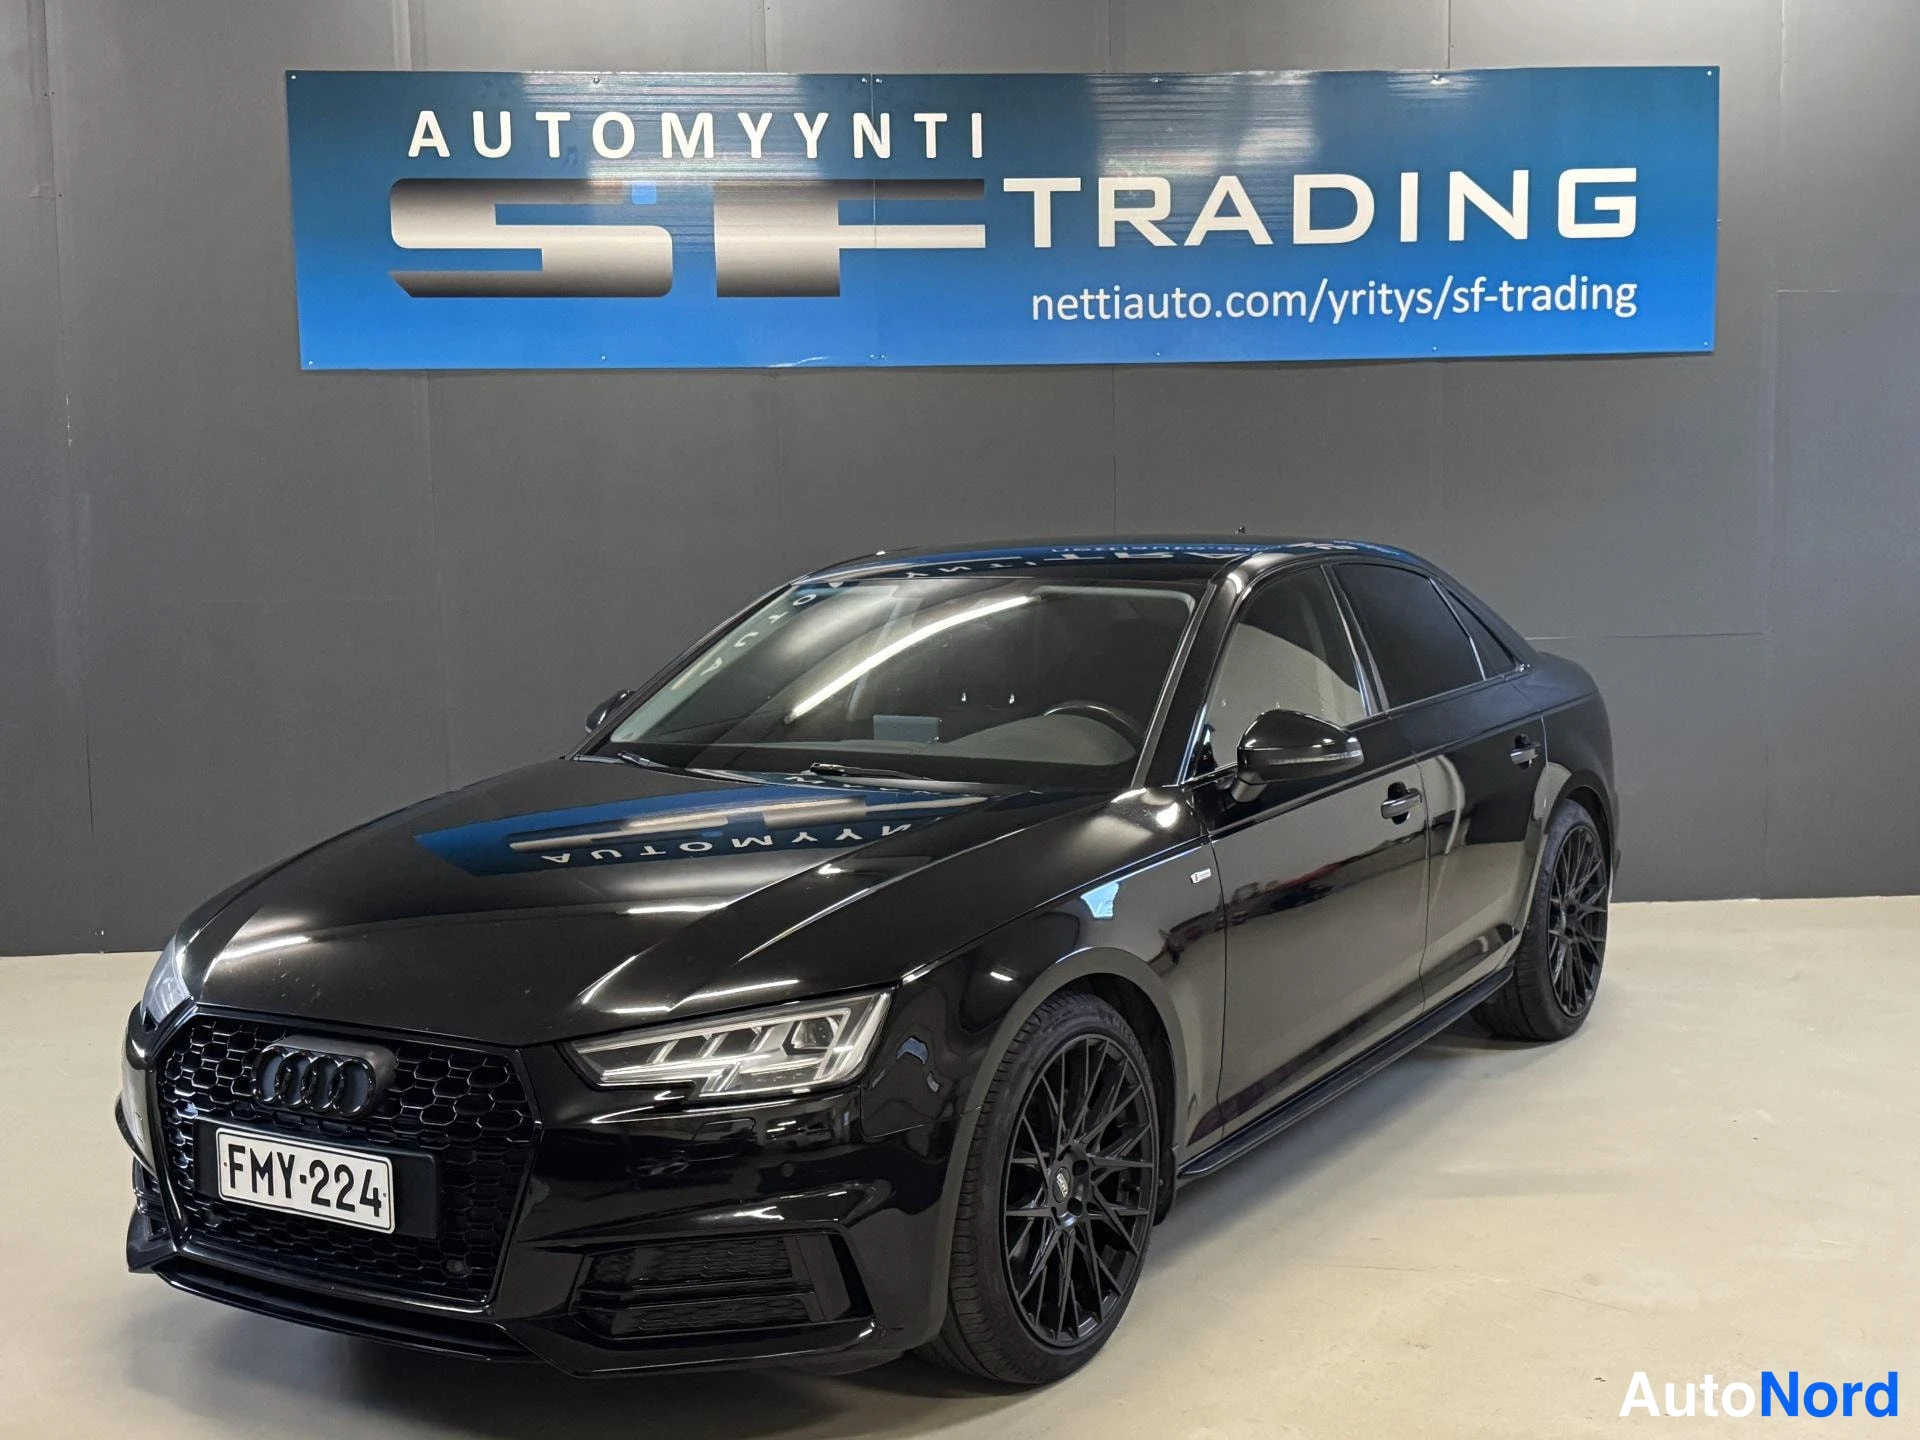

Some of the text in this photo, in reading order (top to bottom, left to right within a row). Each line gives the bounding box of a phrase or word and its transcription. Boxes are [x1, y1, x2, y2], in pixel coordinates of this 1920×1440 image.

[408, 110, 983, 160] AUTOMYYNTI
[388, 167, 1637, 298] SF TRADING
[1031, 274, 1638, 324] nettiauto.com/yritys/sf-trading
[227, 1143, 382, 1218] FMY-224
